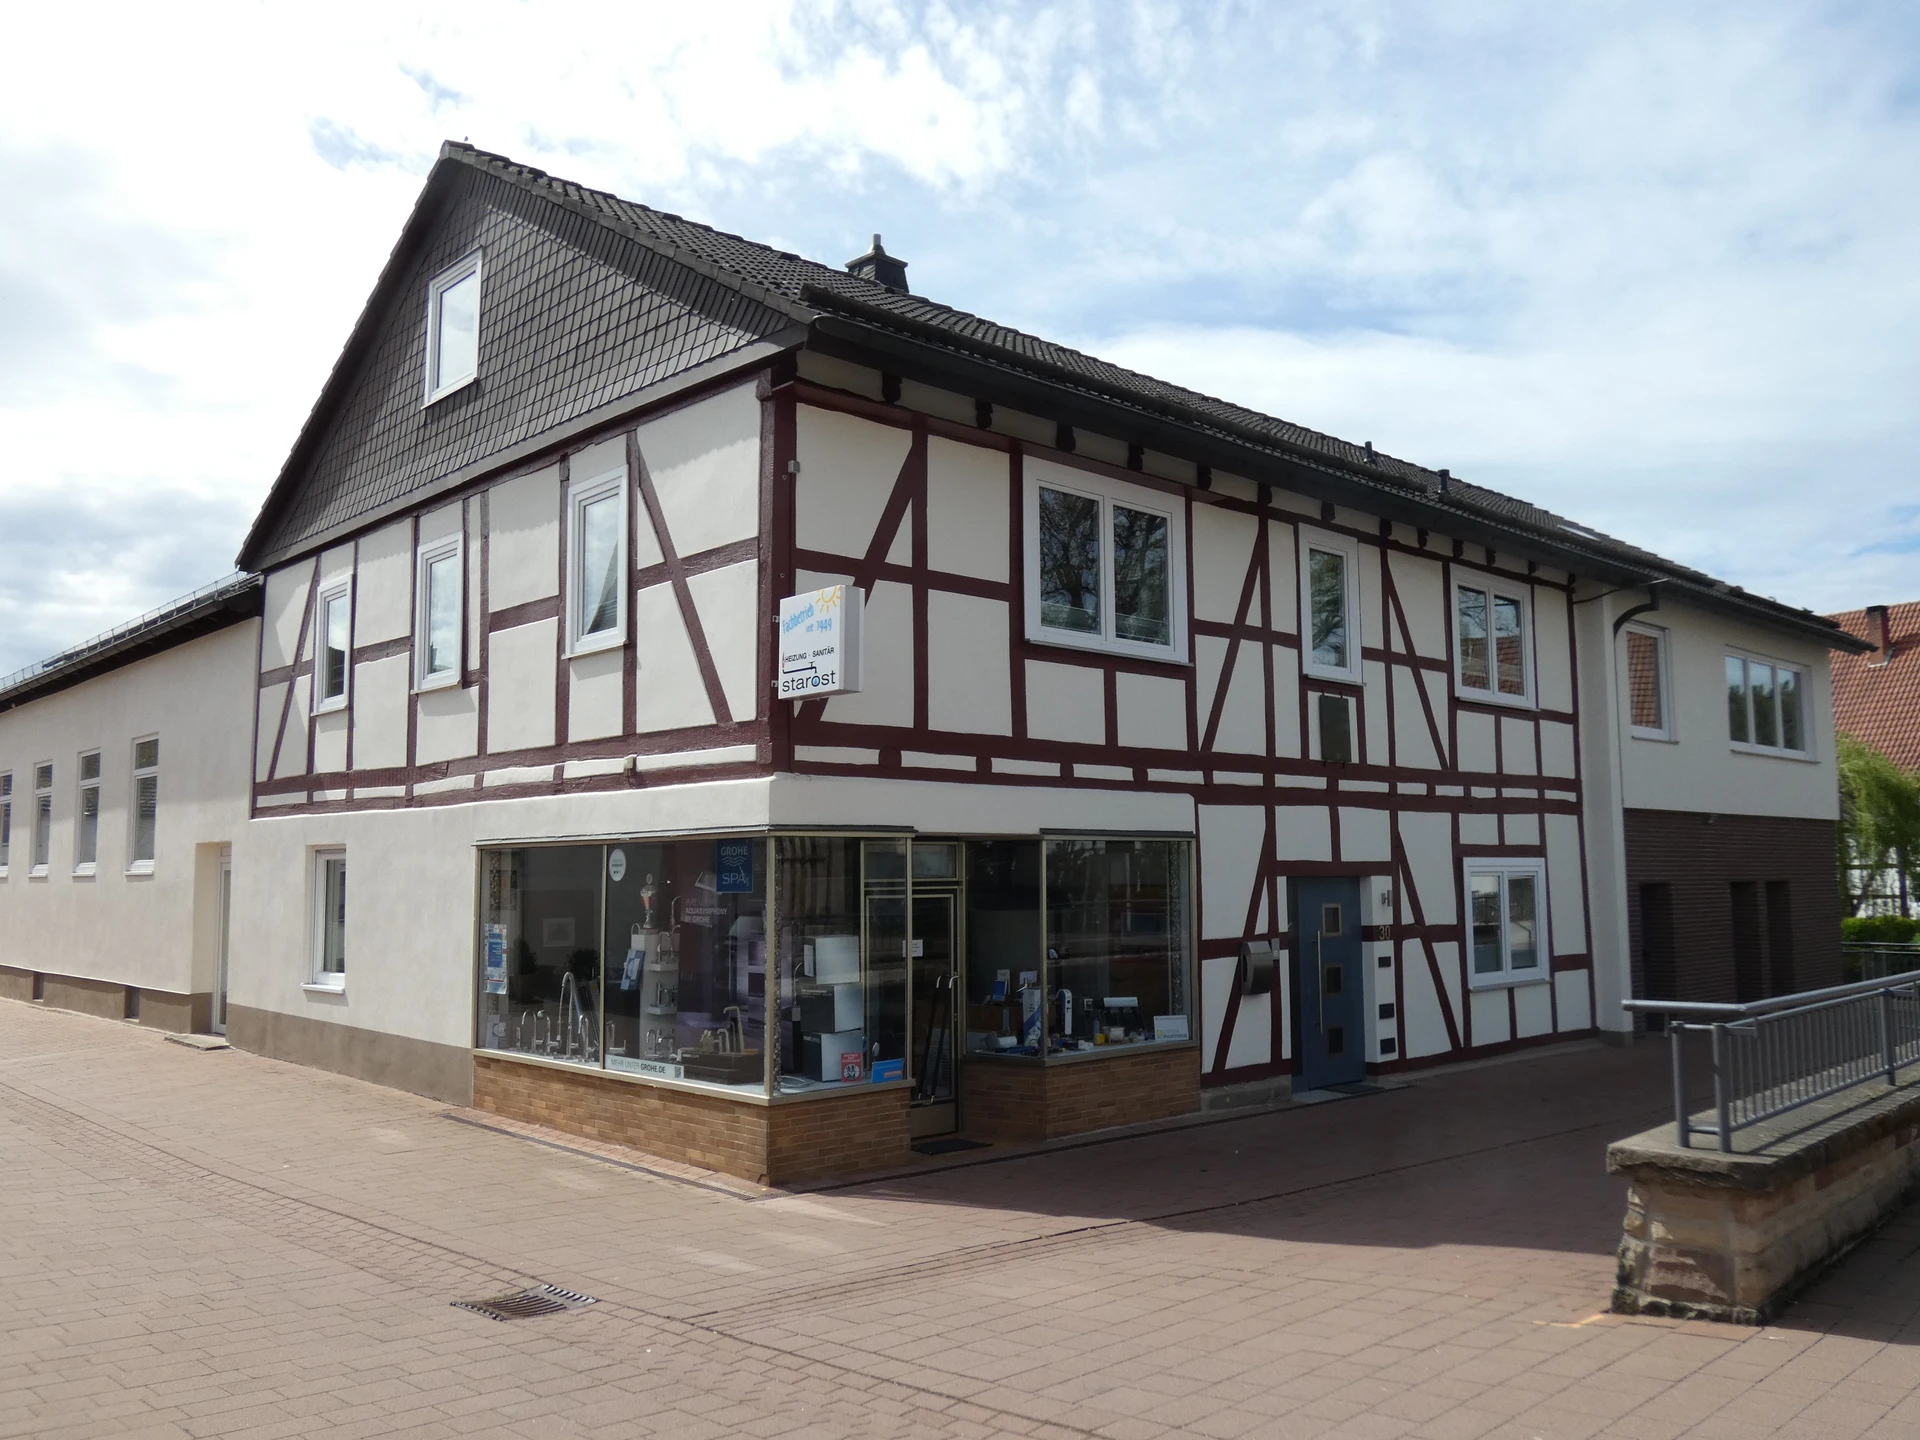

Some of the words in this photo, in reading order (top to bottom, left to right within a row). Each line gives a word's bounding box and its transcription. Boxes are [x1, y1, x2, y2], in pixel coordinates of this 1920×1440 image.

[782, 603, 814, 634] Fachbetrieb
[816, 618, 832, 633] 1949
[785, 652, 807, 663] HEIZUNG
[812, 646, 835, 658] SANITÄR
[782, 670, 836, 692] starost
[720, 846, 749, 856] GROHE
[722, 872, 746, 885] SPA
[692, 916, 711, 924] GROHE
[1379, 925, 1391, 940] 30
[611, 1059, 624, 1068] MEHR
[640, 1063, 666, 1074] GROHE.DE
